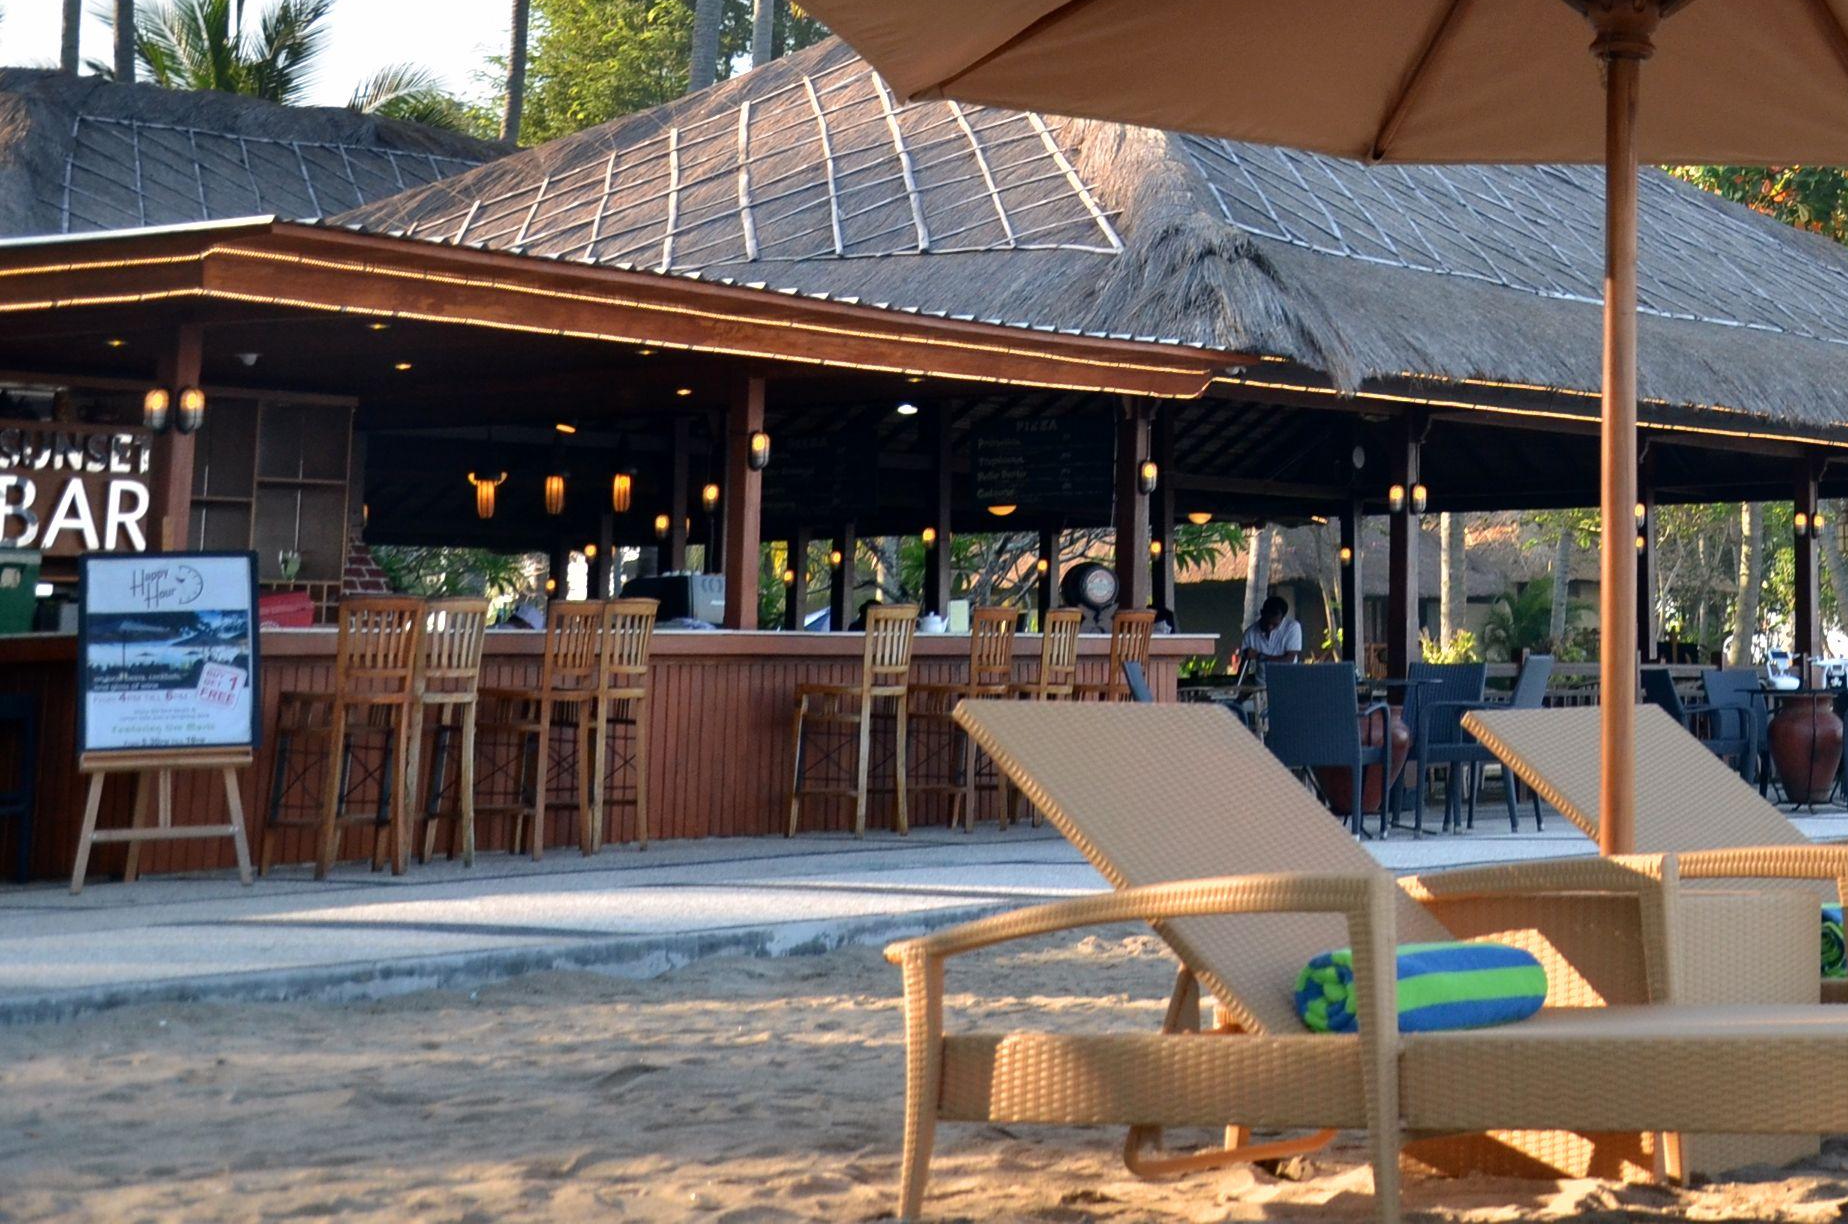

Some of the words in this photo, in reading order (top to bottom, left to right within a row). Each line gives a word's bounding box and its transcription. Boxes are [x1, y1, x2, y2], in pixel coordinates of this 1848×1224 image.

[0, 428, 152, 474] SUNSET
[0, 475, 150, 552] BAR
[129, 568, 169, 596] Happy
[144, 579, 177, 608] Hour
[200, 687, 236, 705] FREE
[229, 676, 238, 691] 1
